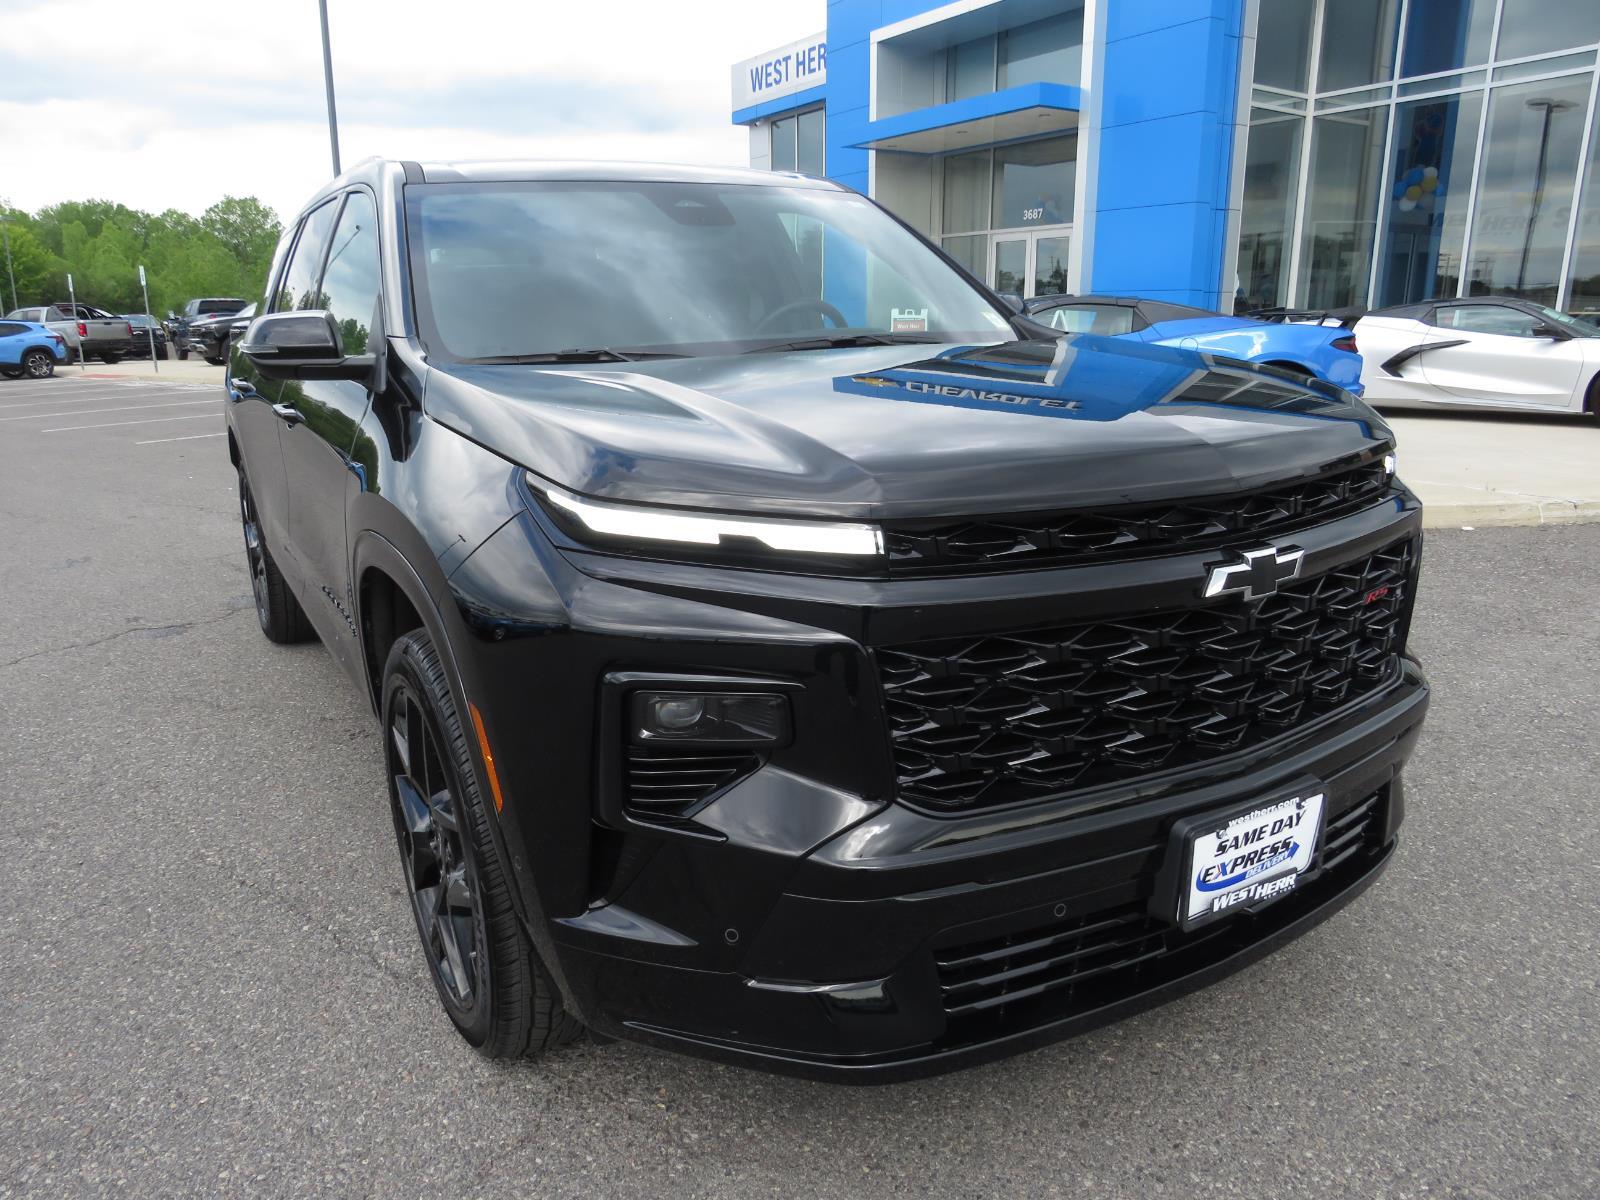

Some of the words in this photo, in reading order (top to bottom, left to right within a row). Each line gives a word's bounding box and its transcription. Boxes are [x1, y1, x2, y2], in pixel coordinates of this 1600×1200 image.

[750, 55, 792, 93] WEST
[796, 43, 827, 78] HER
[1023, 208, 1043, 220] 3687
[1228, 797, 1299, 828] westherr.com
[1214, 824, 1269, 857] SAME
[1269, 809, 1307, 836] DAY
[1202, 836, 1293, 884] EXPRESS
[1245, 852, 1289, 879] DELIVERY
